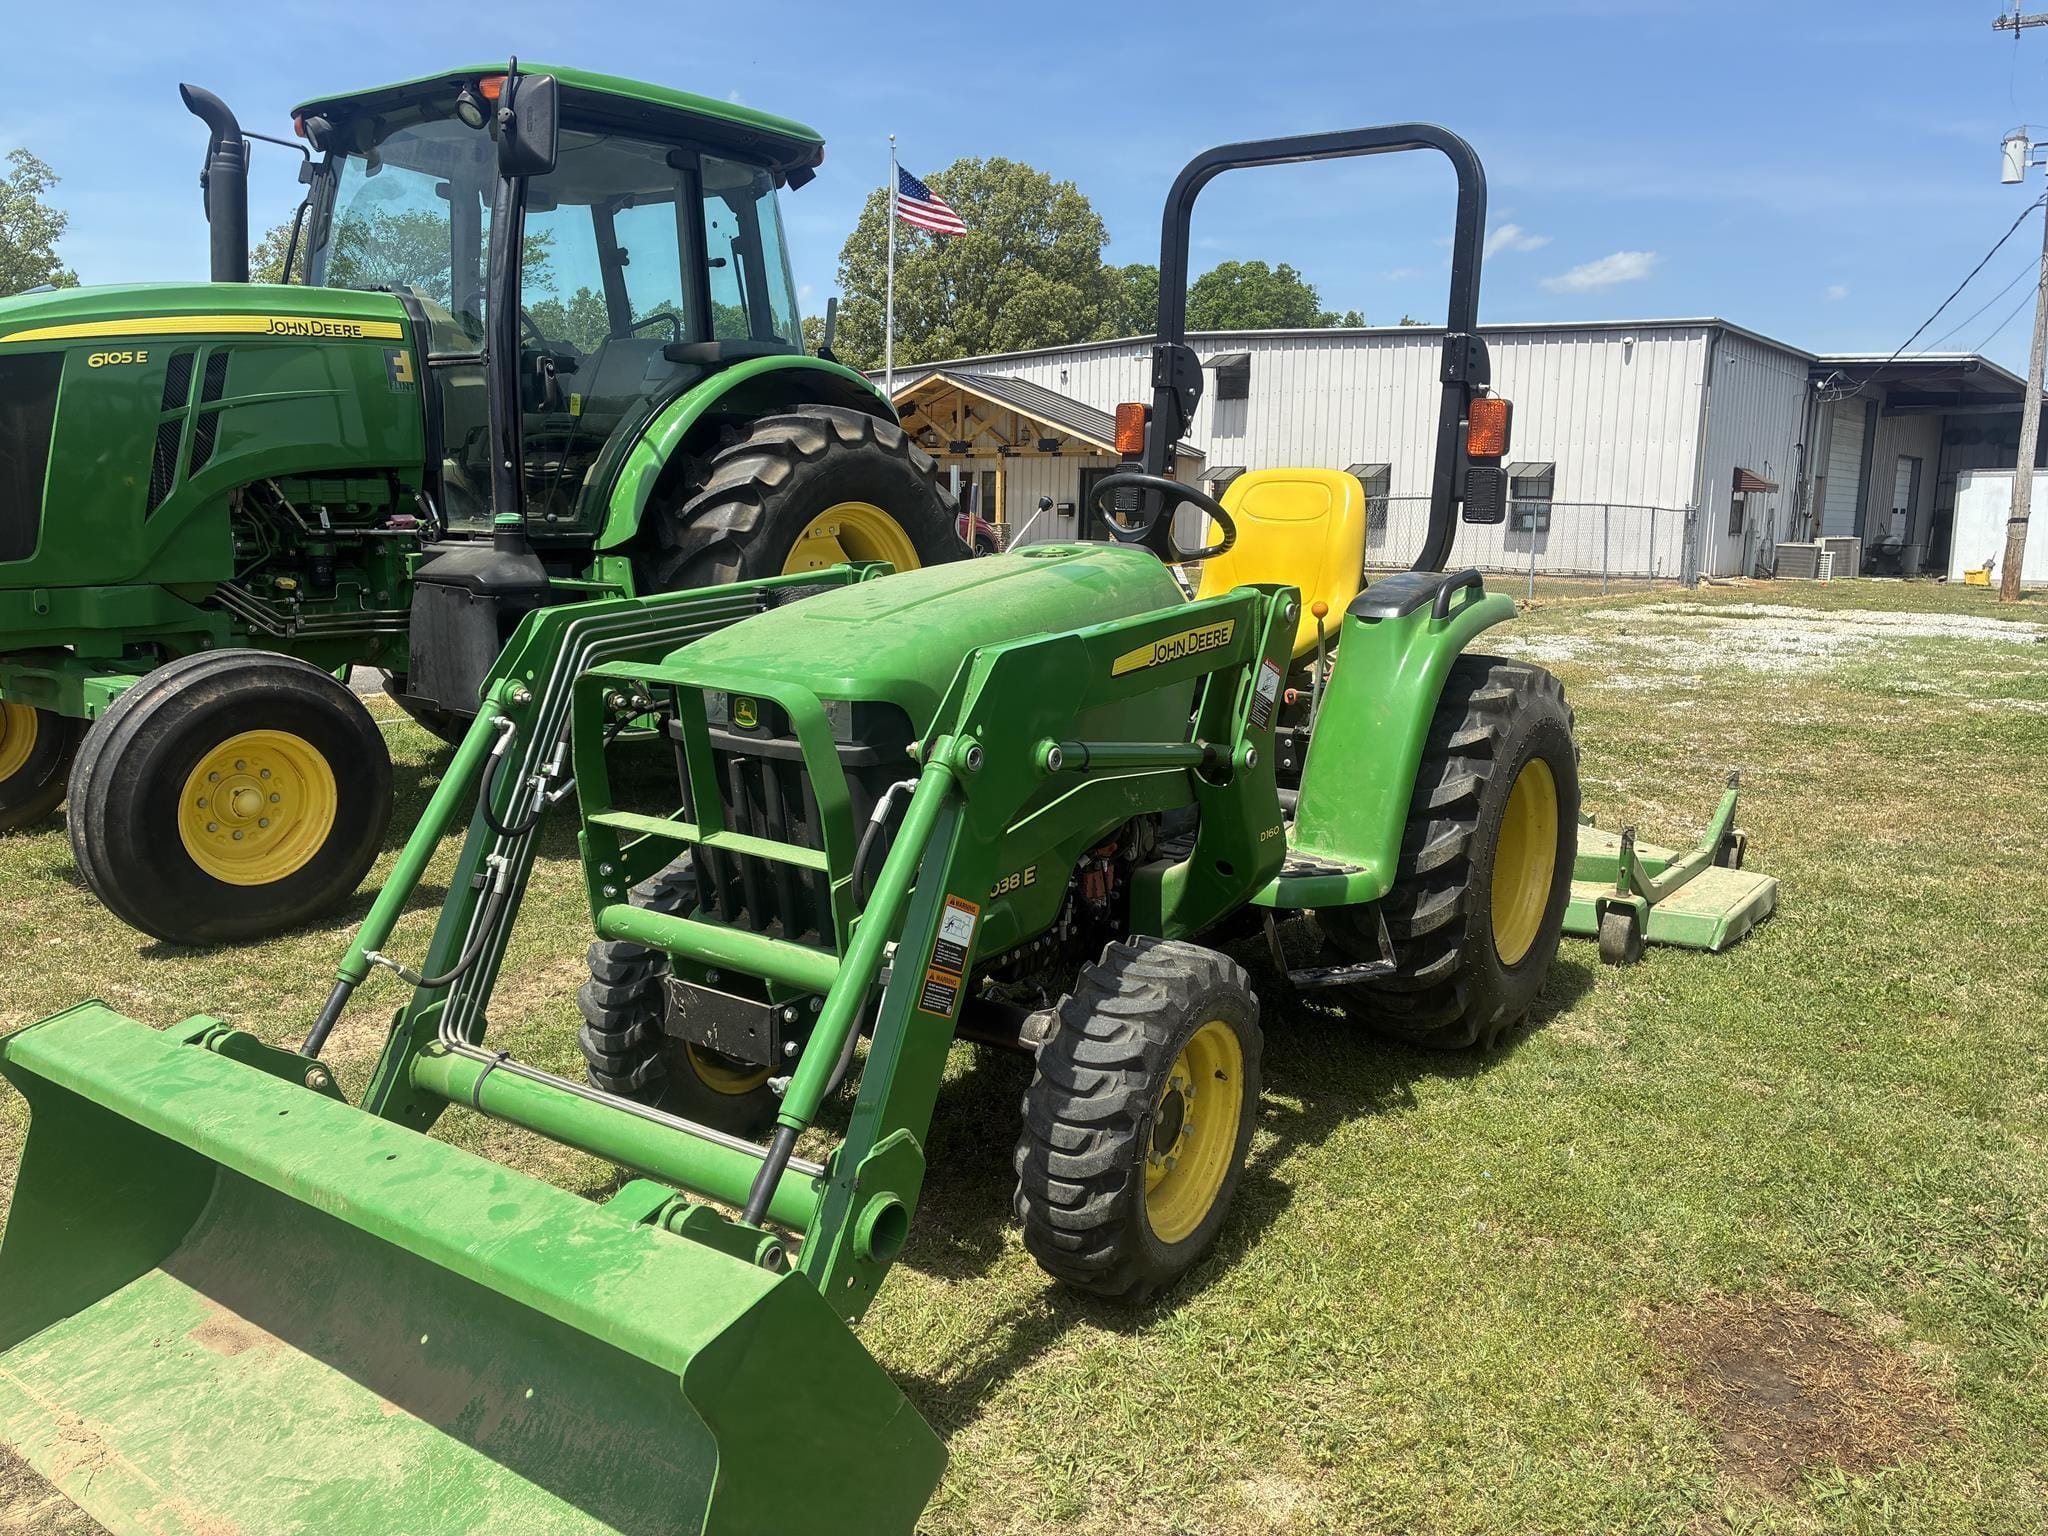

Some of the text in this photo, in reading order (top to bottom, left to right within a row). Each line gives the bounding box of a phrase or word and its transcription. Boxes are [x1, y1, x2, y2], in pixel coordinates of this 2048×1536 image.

[265, 318, 362, 337] JOHN DEERE
[88, 351, 148, 368] 6105 E
[1149, 627, 1229, 665] JOHN DEERE
[1260, 825, 1280, 842] D160
[1023, 865, 1037, 886] E
